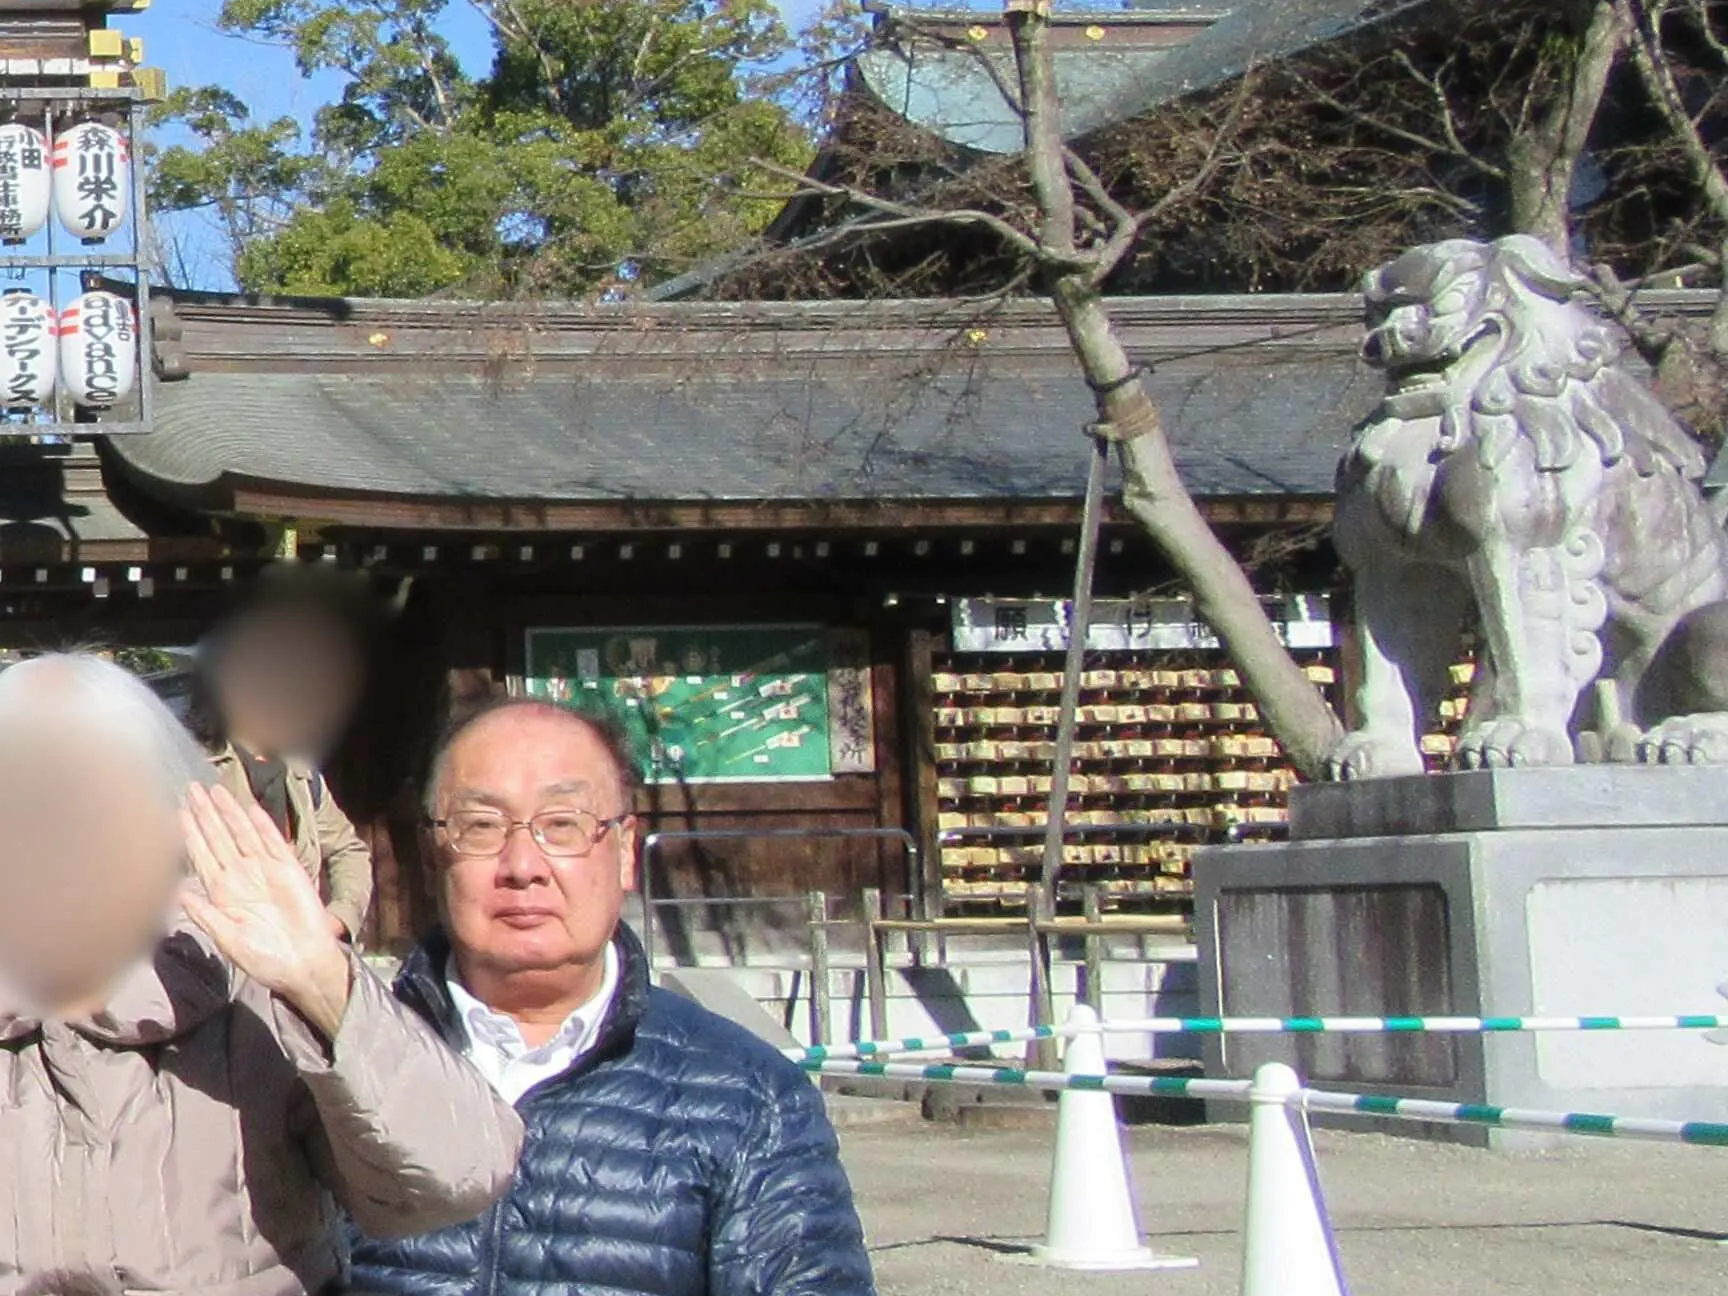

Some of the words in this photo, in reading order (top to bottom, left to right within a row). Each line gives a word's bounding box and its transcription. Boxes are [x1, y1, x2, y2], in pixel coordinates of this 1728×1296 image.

[18, 128, 43, 170] 小田
[76, 127, 118, 231] 森川栄介
[82, 296, 119, 402] advance
